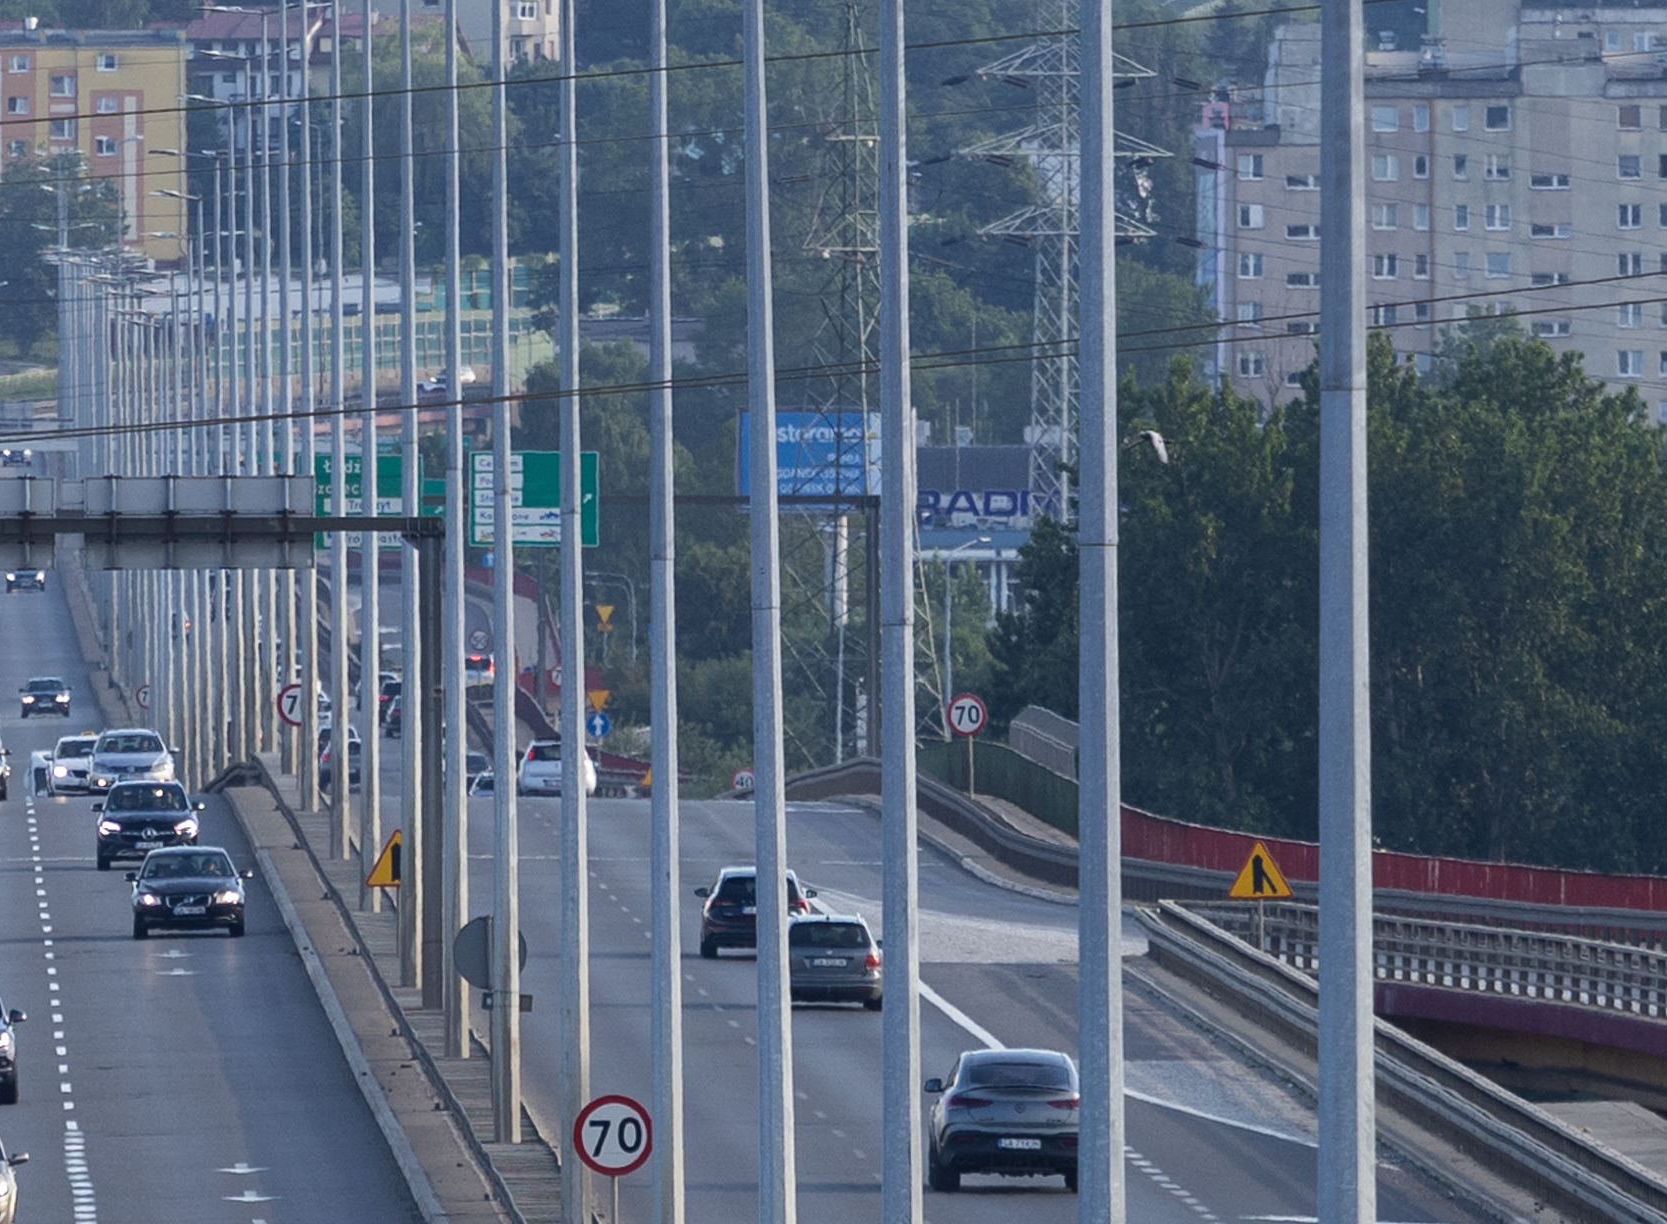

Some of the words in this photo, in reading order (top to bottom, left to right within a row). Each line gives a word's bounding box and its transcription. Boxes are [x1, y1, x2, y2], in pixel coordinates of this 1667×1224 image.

[777, 424, 862, 443] storama
[323, 459, 361, 473] Łdź
[286, 695, 298, 715] 7
[955, 705, 980, 724] 70
[589, 1116, 642, 1157] 70
